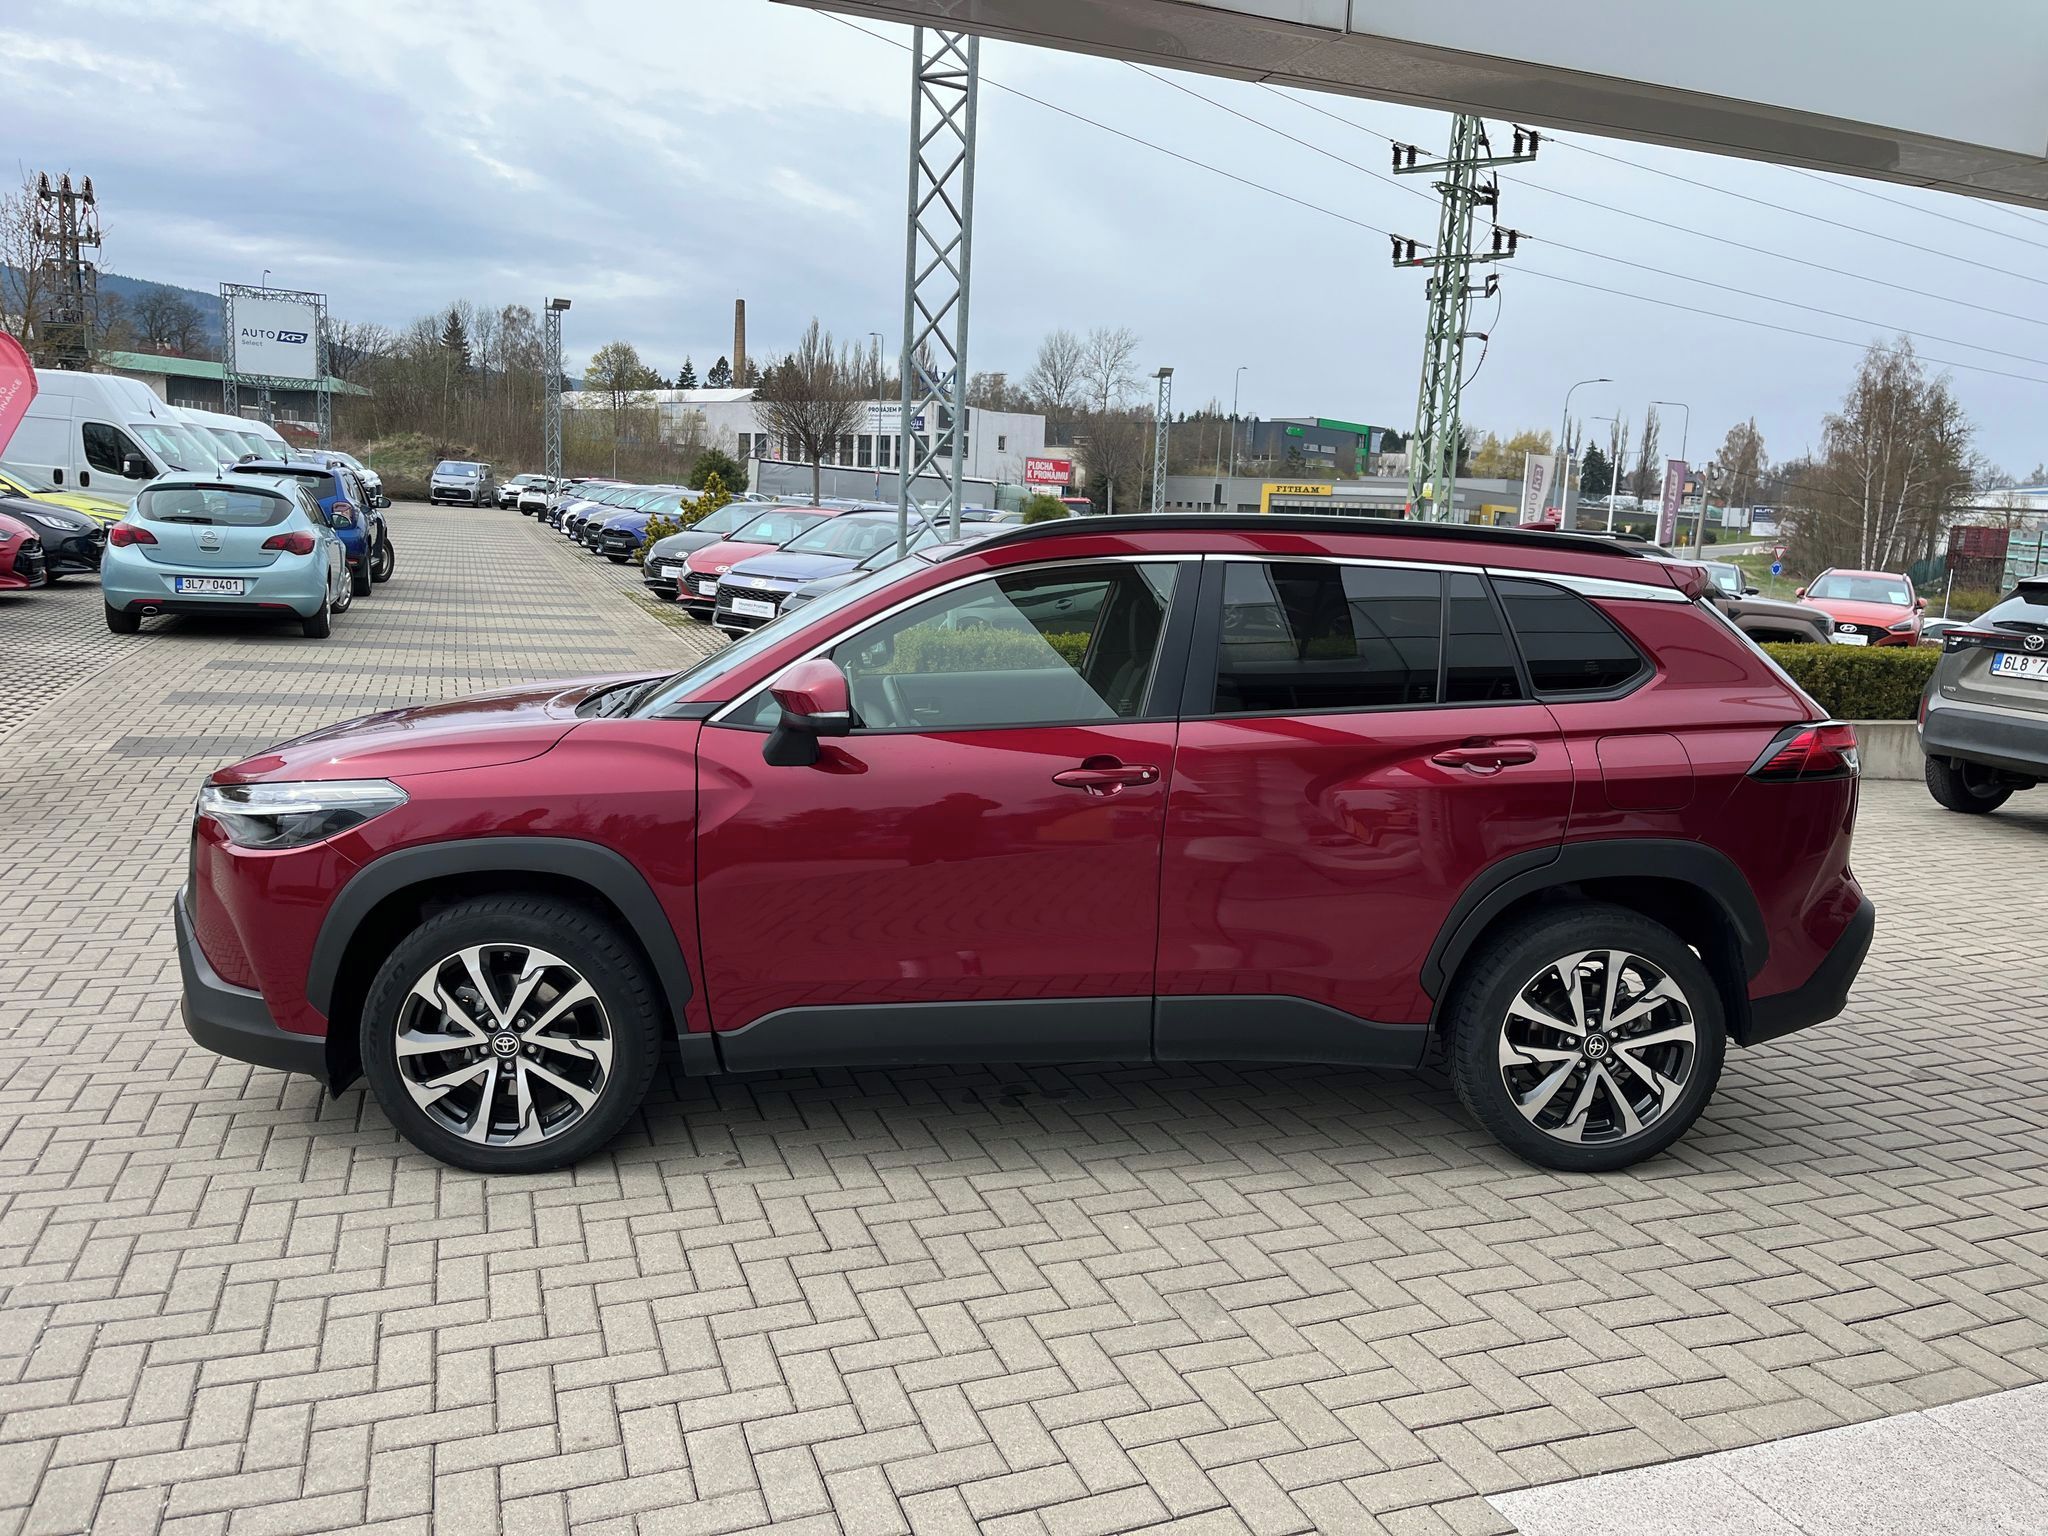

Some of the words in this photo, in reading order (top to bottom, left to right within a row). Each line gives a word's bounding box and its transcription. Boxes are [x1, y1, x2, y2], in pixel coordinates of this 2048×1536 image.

[241, 328, 275, 339] AUTO
[0, 378, 22, 416] INANCE
[1027, 469, 1033, 479] K
[1276, 485, 1320, 494] FITHAM
[1527, 492, 1538, 522] AUTO
[1665, 502, 1675, 535] AUTO
[185, 579, 204, 590] 3L7
[212, 580, 239, 590] 0401
[2003, 656, 2029, 671] 6L8
[2037, 659, 2048, 674] 7
